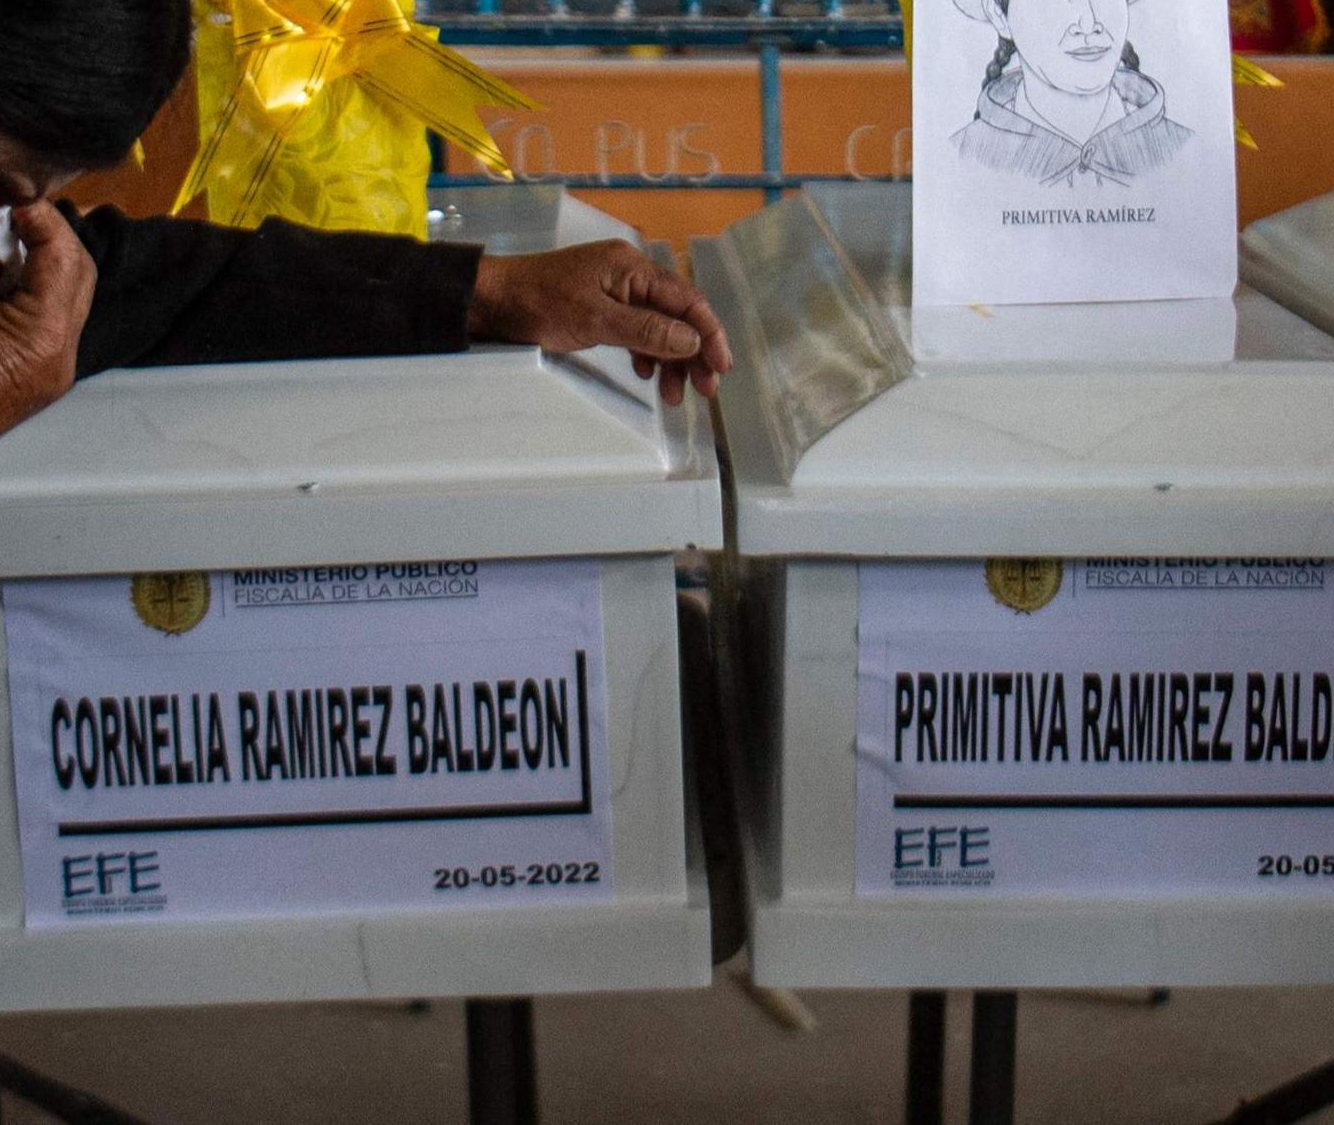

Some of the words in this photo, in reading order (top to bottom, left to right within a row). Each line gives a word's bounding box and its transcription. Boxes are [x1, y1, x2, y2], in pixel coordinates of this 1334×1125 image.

[1001, 209, 1082, 225] PRIMITIVA
[1085, 204, 1156, 224] RAMÍREZ
[233, 564, 367, 585] MINISTERIO
[331, 584, 359, 600] DE
[366, 582, 391, 598] LA
[398, 577, 479, 597] NACIÓN
[1181, 570, 1207, 586] DE
[1215, 570, 1240, 586] LA
[1246, 566, 1324, 586] NACIÓN
[51, 691, 231, 790] CORNELIA
[239, 683, 397, 782] RAMIREZ
[405, 676, 570, 776] BALDEON
[893, 671, 1069, 763] PRIMITIVA
[1080, 671, 1234, 763] RAMIREZ
[894, 825, 990, 869] EFE
[62, 850, 161, 898] EFE
[433, 861, 602, 891] 20-05-2022
